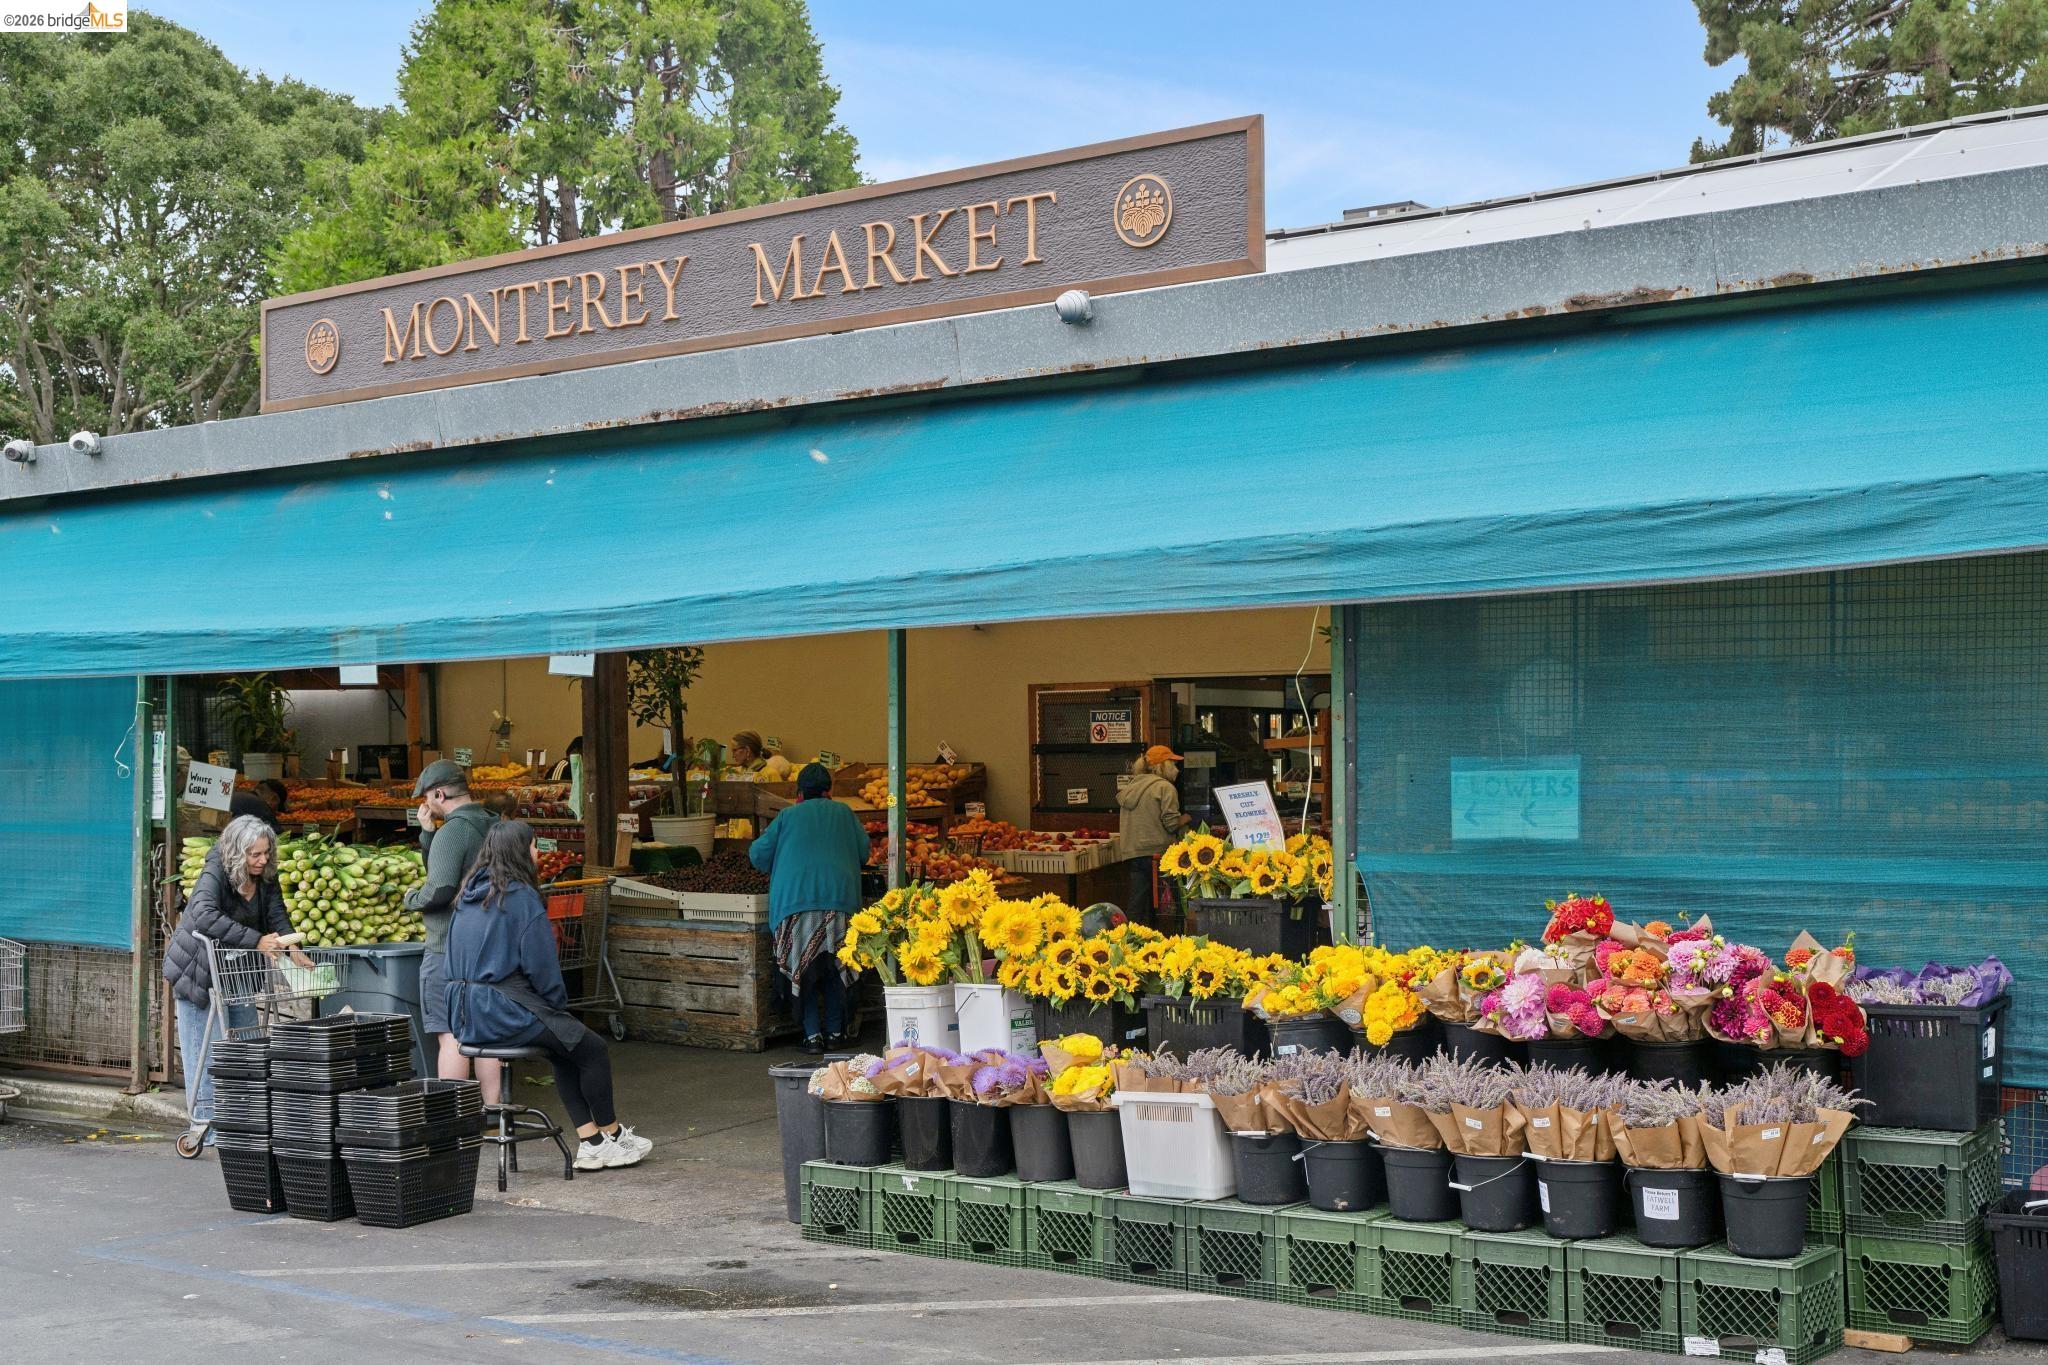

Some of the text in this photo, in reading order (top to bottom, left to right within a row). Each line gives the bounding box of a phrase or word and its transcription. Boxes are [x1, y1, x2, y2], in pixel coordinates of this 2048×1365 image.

[380, 191, 1057, 365] MONTEREY MARKET
[1095, 712, 1127, 721] NOTICE
[190, 771, 212, 785] WHITE
[188, 783, 208, 796] CORN
[1229, 790, 1259, 800] FRESHLY
[1235, 809, 1267, 818] FLOWERS
[1652, 1204, 1670, 1212] FARM
